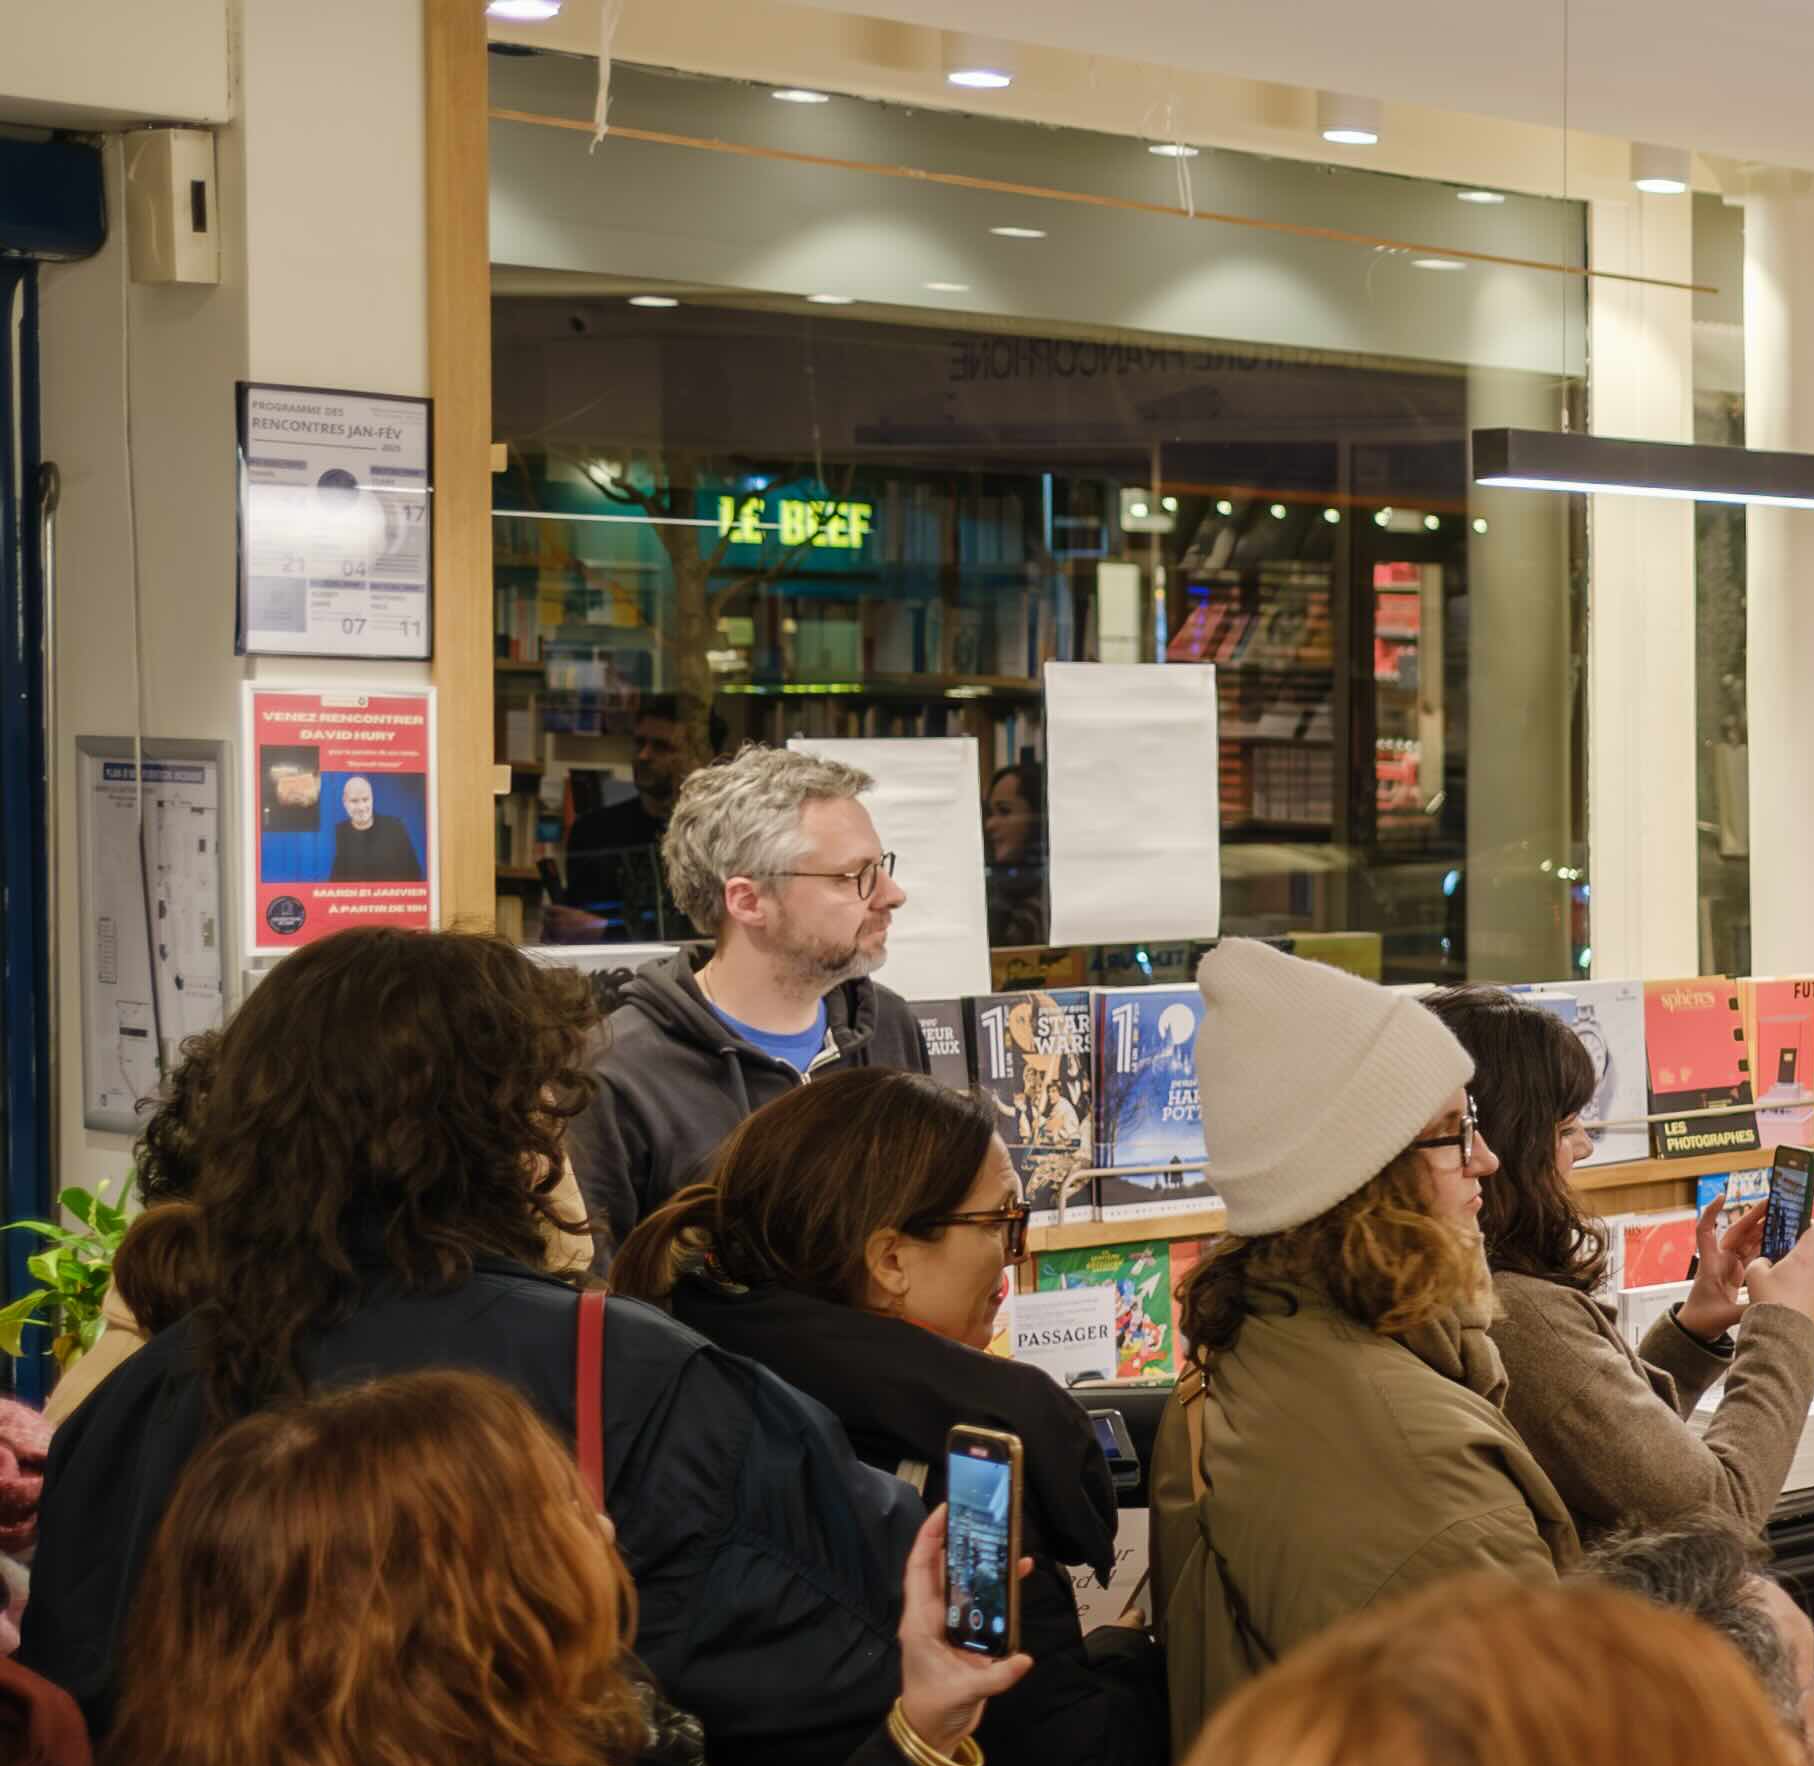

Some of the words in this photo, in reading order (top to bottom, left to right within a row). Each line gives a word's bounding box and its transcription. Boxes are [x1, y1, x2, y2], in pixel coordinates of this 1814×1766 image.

[251, 400, 321, 416] PROGRAMME
[324, 406, 344, 417] DES
[252, 417, 345, 436] RENCONTRES
[347, 424, 403, 440] JAN-FÉV
[403, 504, 425, 521] 17
[343, 561, 367, 578] 04
[341, 618, 367, 635] 07
[400, 620, 422, 637] 11
[262, 711, 318, 723] VENEZ
[319, 712, 424, 725] RENCONTRER
[299, 729, 352, 741] DAVID
[1036, 1013, 1091, 1035] STAR
[1034, 1034, 1092, 1055] WARS
[1162, 1106, 1204, 1122] POTT
[1664, 1121, 1687, 1136] LES
[1667, 1130, 1756, 1152] PHOTOGRAPHES
[1017, 1324, 1109, 1348] PASSAGER
